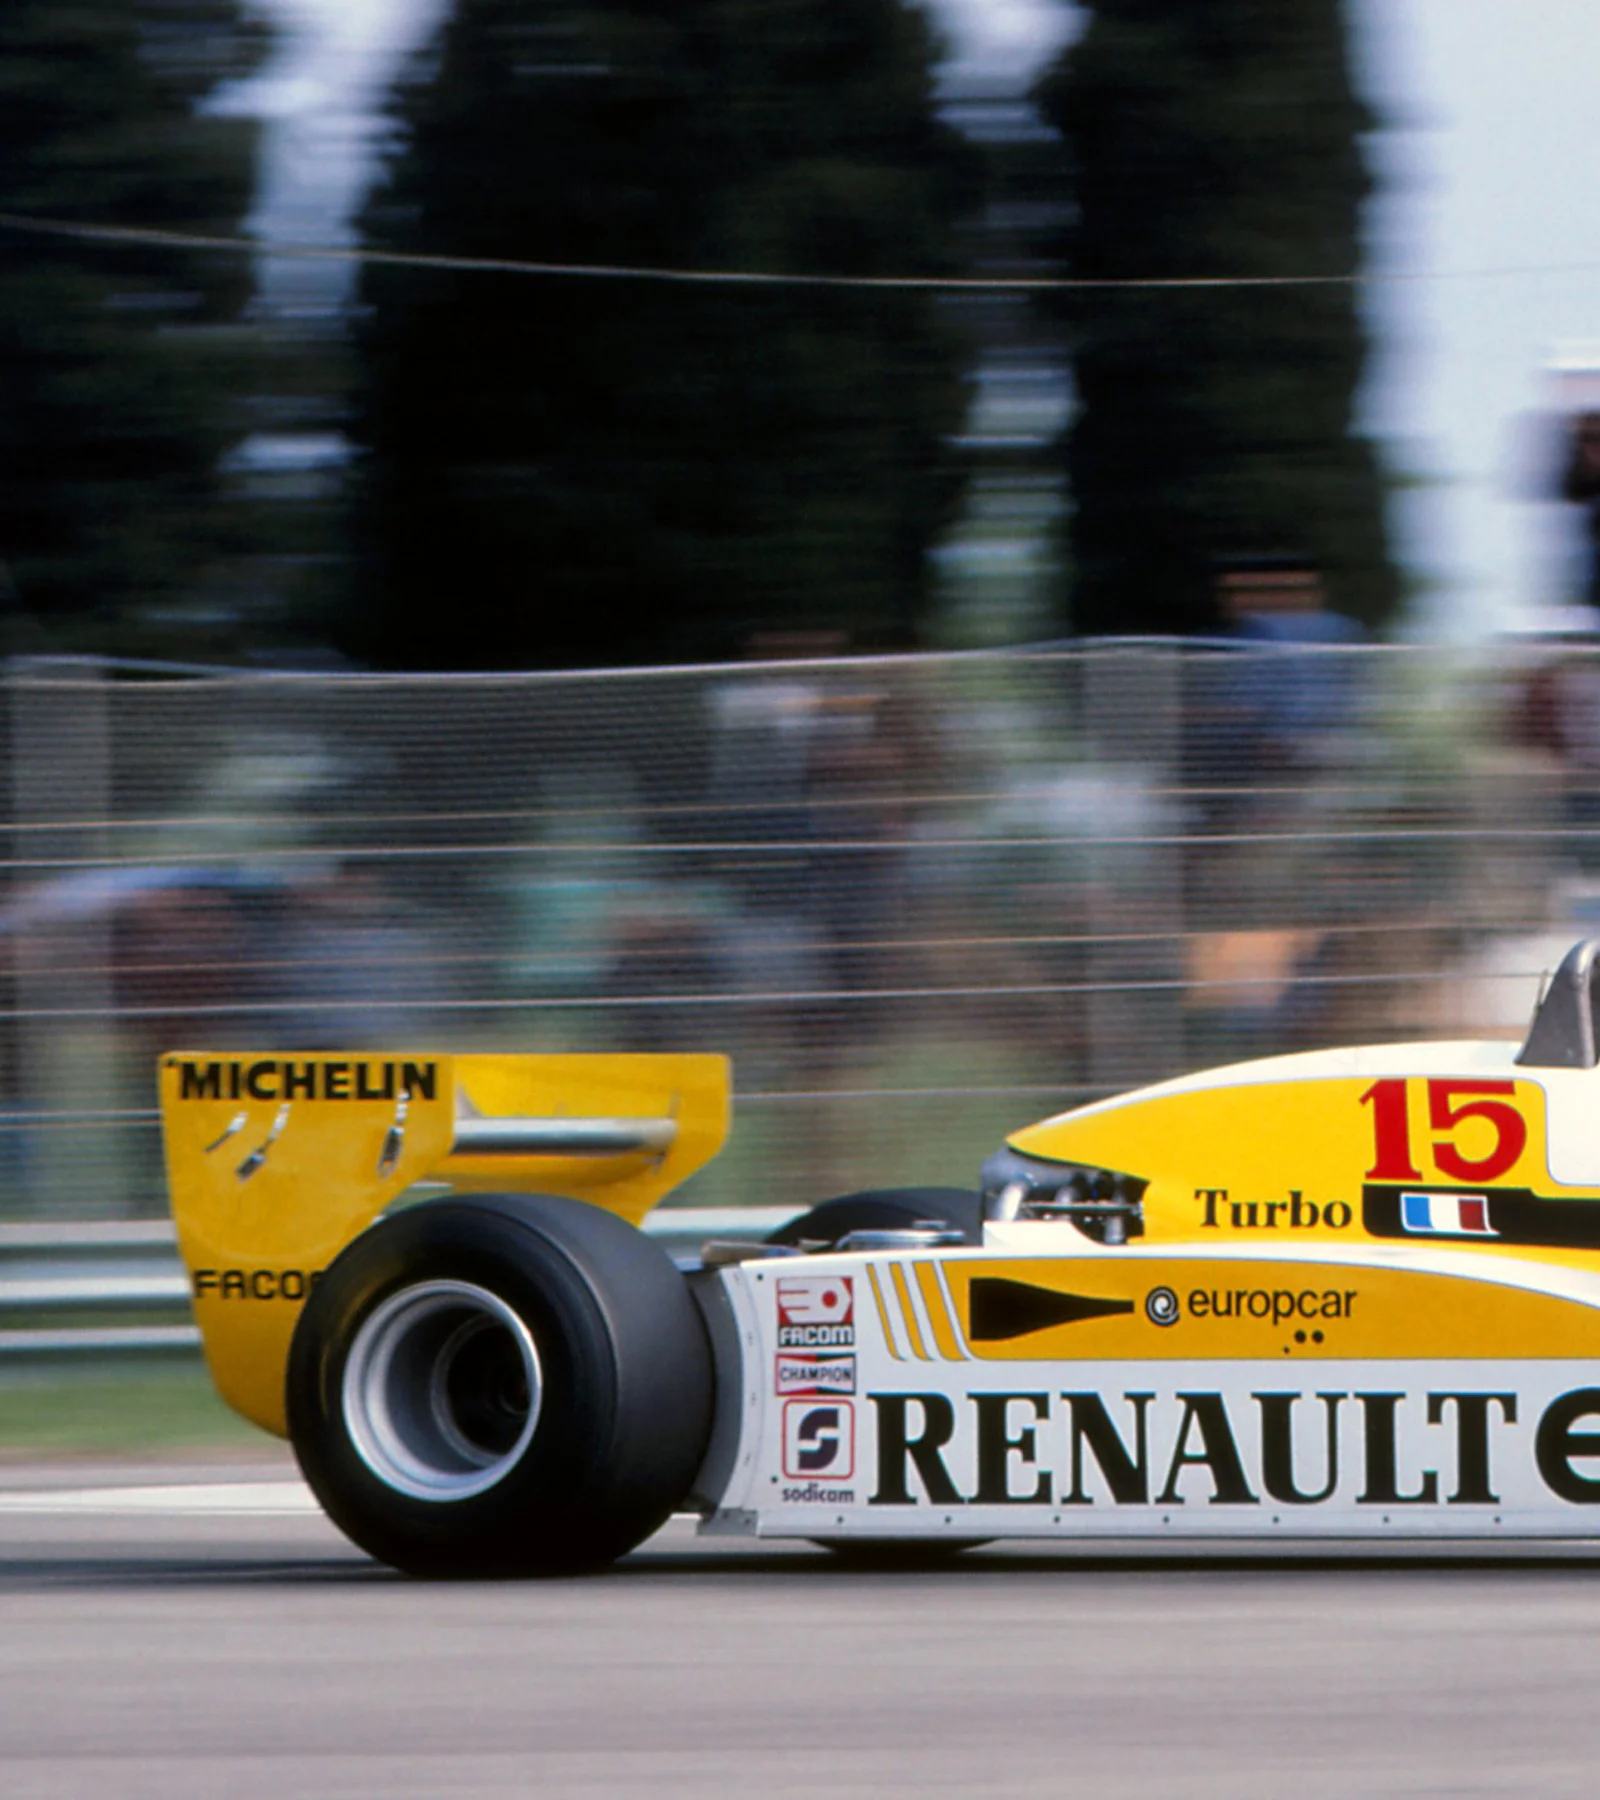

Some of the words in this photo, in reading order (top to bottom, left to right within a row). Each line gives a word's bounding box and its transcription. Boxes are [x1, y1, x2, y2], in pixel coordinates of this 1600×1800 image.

[179, 1060, 438, 1101] MICHELIN
[1359, 1078, 1527, 1183] 15
[1195, 1189, 1353, 1229] Turbo
[1188, 1289, 1358, 1326] europcar
[780, 1325, 853, 1345] FACOM
[780, 1365, 853, 1382] CHAMPION
[866, 1390, 1518, 1505] RENAULT
[782, 1483, 854, 1503] sodicam
